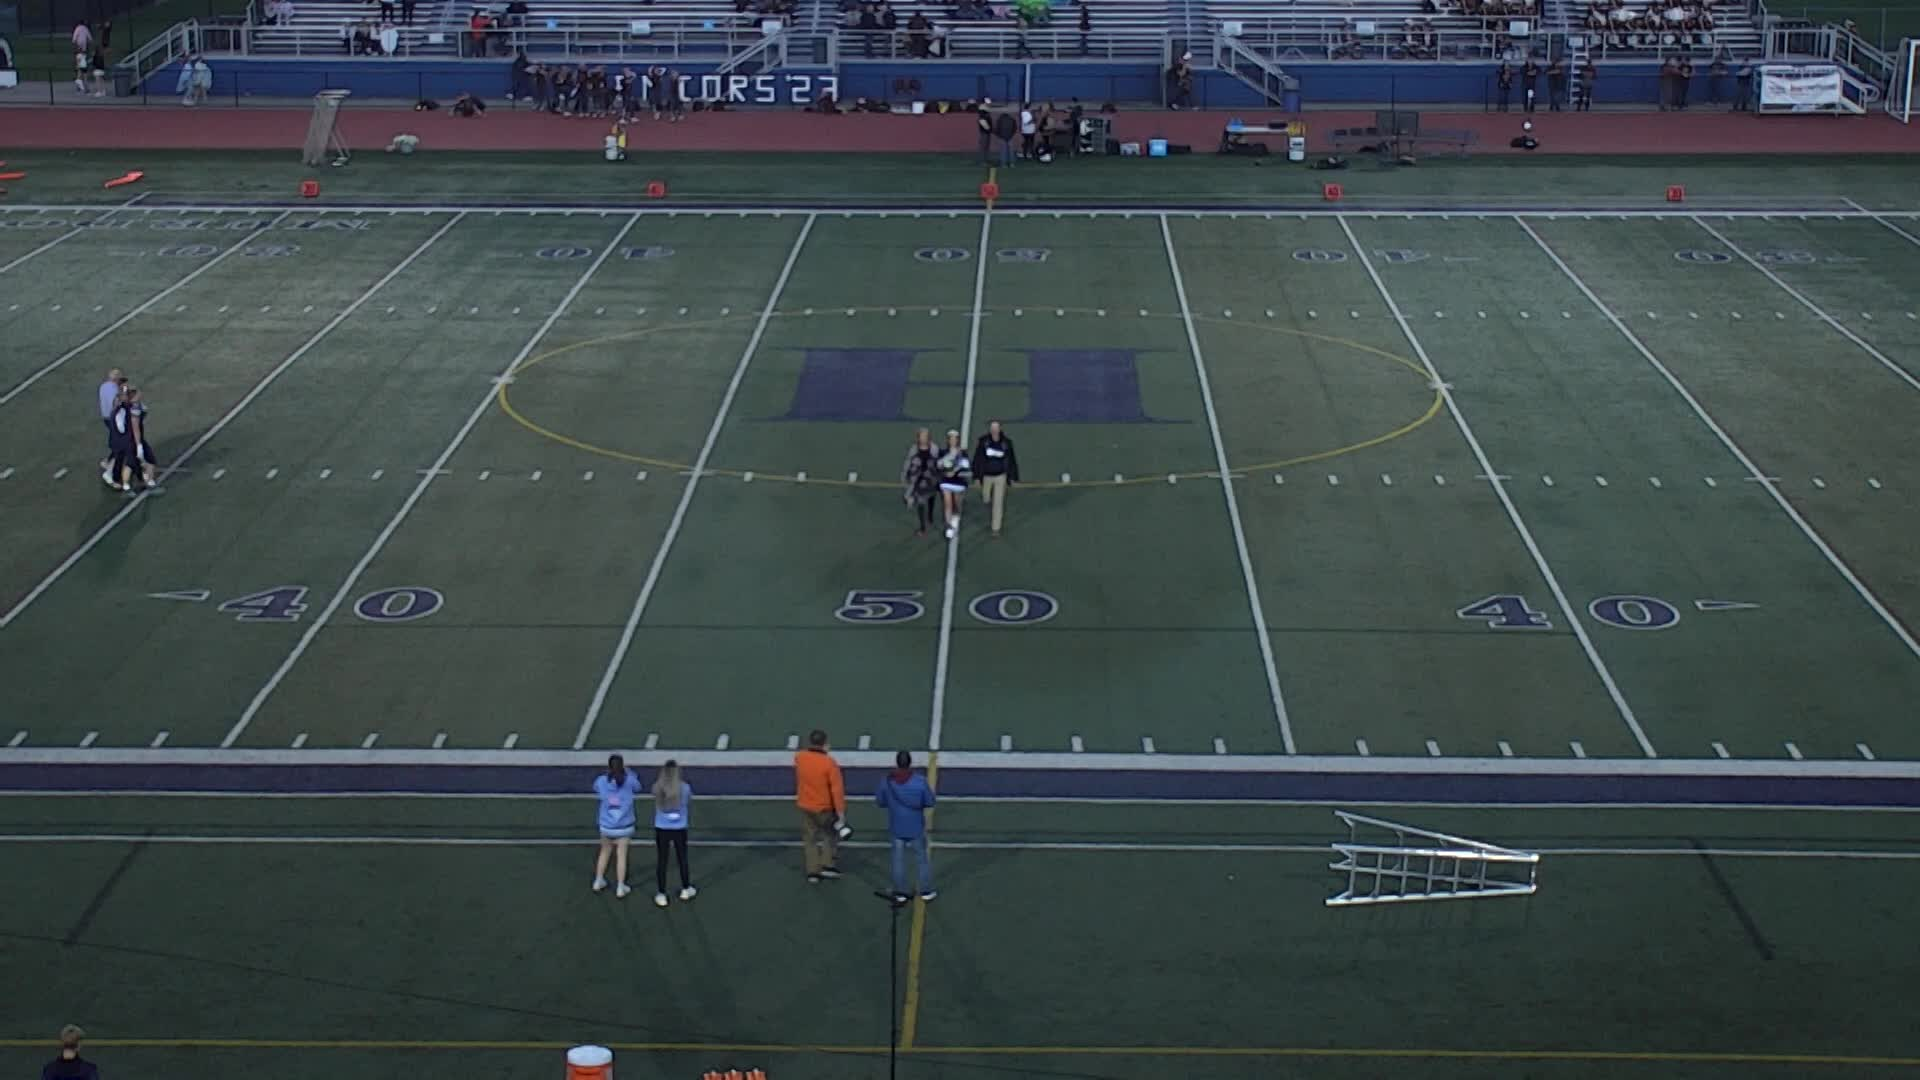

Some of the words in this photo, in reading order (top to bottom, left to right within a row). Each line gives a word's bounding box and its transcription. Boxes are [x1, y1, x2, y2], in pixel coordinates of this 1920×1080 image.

[218, 585, 445, 623] 40
[834, 589, 1059, 625] 50
[1456, 594, 1681, 631] 40
